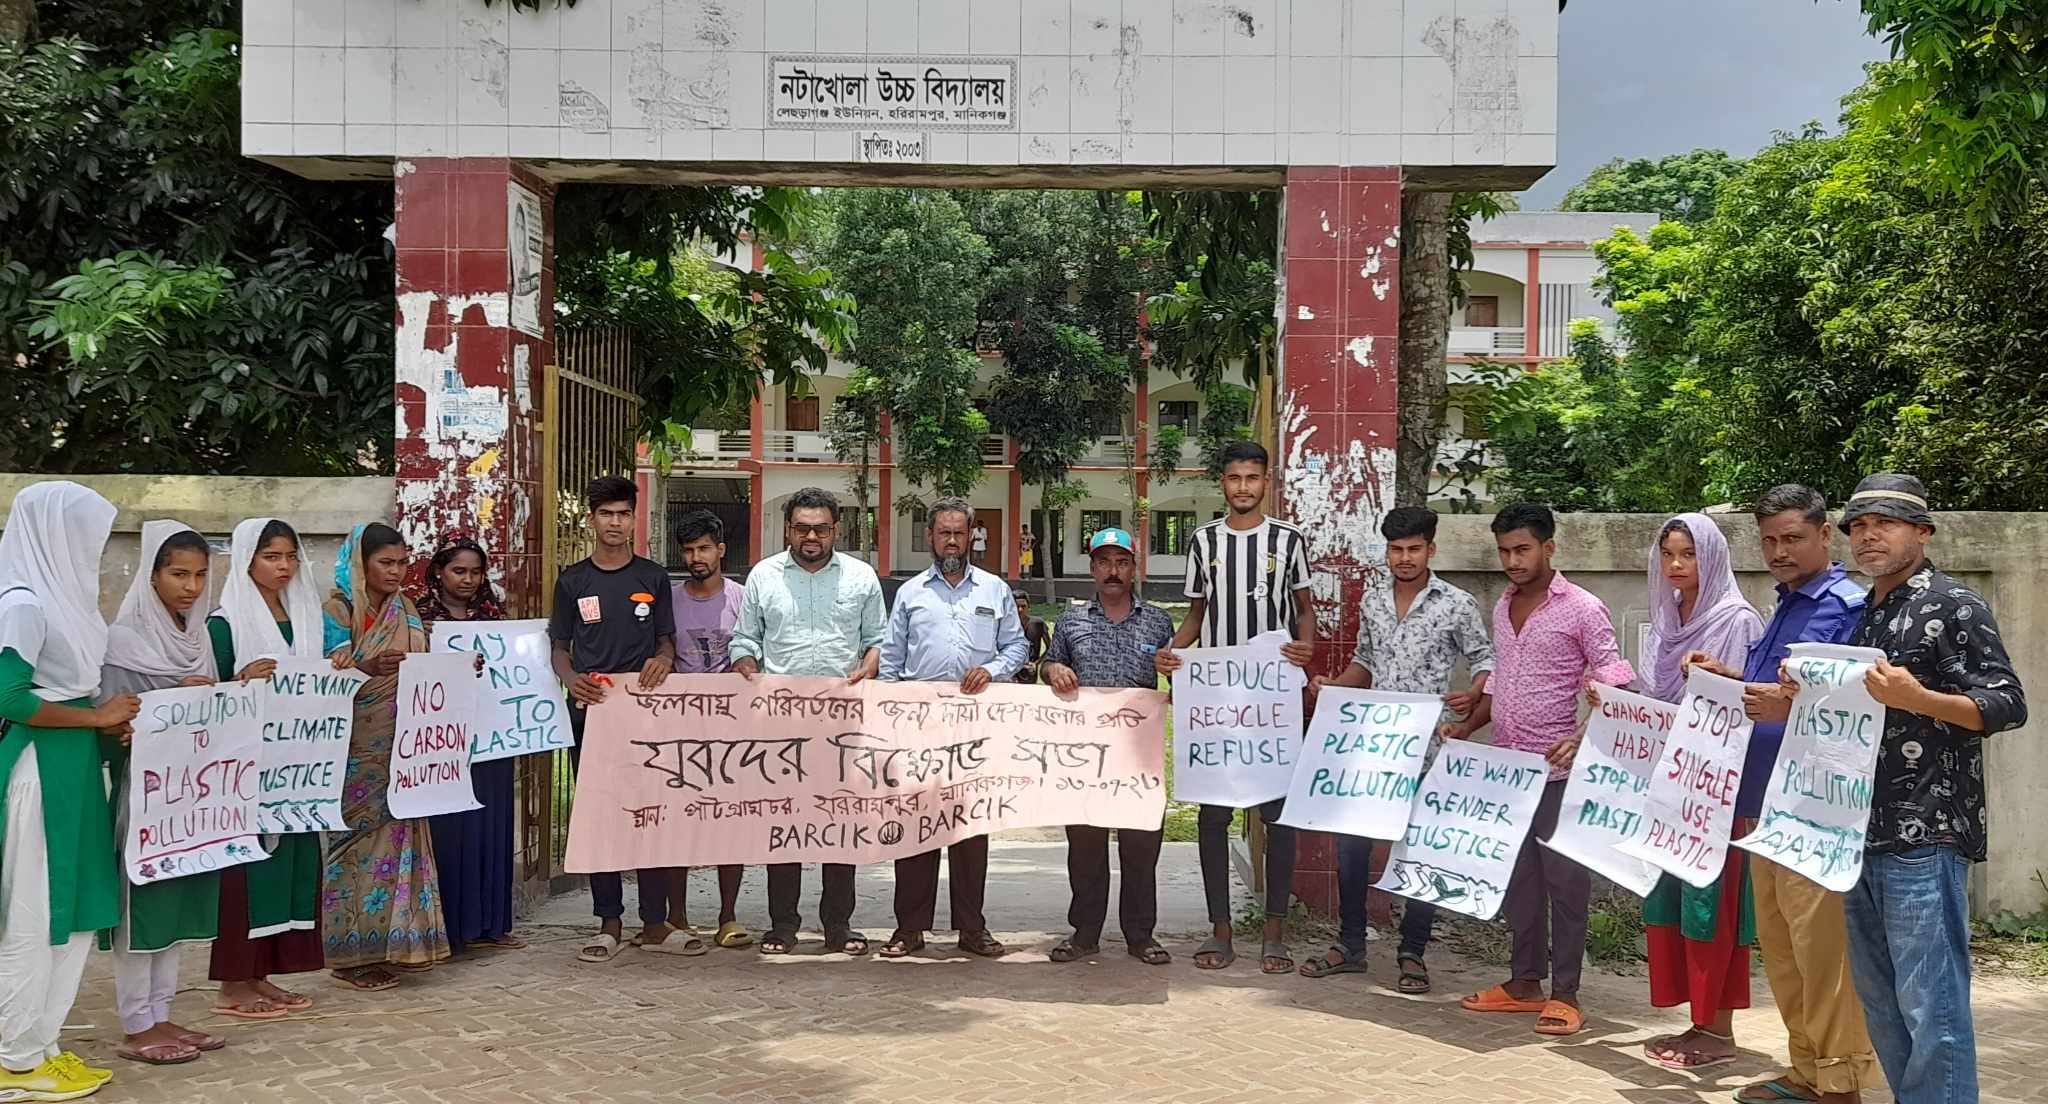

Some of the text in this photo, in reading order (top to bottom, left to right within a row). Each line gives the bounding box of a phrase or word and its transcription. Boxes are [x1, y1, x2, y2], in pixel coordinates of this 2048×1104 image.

[779, 64, 1006, 106] নটাখোলা উচ্চ বিদ্যালয়
[953, 107, 1007, 121] মানিকগঞ্জ
[896, 140, 921, 160] ২০০৩
[272, 671, 362, 697] WE WANT
[489, 664, 531, 689] NO
[1189, 659, 1291, 692] REDUCE
[151, 687, 258, 735] SOLUTION
[412, 680, 446, 717] NO
[500, 693, 555, 729] TO
[625, 685, 738, 720] জলবায়ু
[750, 688, 864, 724] পরিবর্তনের
[878, 700, 932, 730] জন্য
[1189, 703, 1291, 730] RECYCLE
[1339, 702, 1412, 728] STOP
[262, 715, 348, 743] CLIMATE
[1687, 694, 1743, 747] STOP
[192, 729, 210, 752] TO
[398, 722, 467, 760] CARBON
[1188, 737, 1292, 769] REFUSE
[1322, 731, 1422, 760] PLASTIC
[630, 737, 814, 792] যুবদের
[1011, 735, 1112, 779] সভা
[1444, 753, 1543, 791] WE WANT
[1583, 763, 1629, 793] STOP
[1667, 746, 1739, 807] SINGLE
[143, 758, 256, 813] PLASTIC
[1780, 758, 1871, 811] POLLUTION
[768, 794, 1018, 852] BARCIK BARCIK
[1424, 791, 1513, 826] GENDER
[1577, 798, 1642, 837] PLASTI
[1682, 797, 1715, 833] USE
[139, 806, 247, 857] POLLUTION
[1405, 822, 1510, 863] JUSTICE
[1643, 819, 1715, 872] PLASTIC
